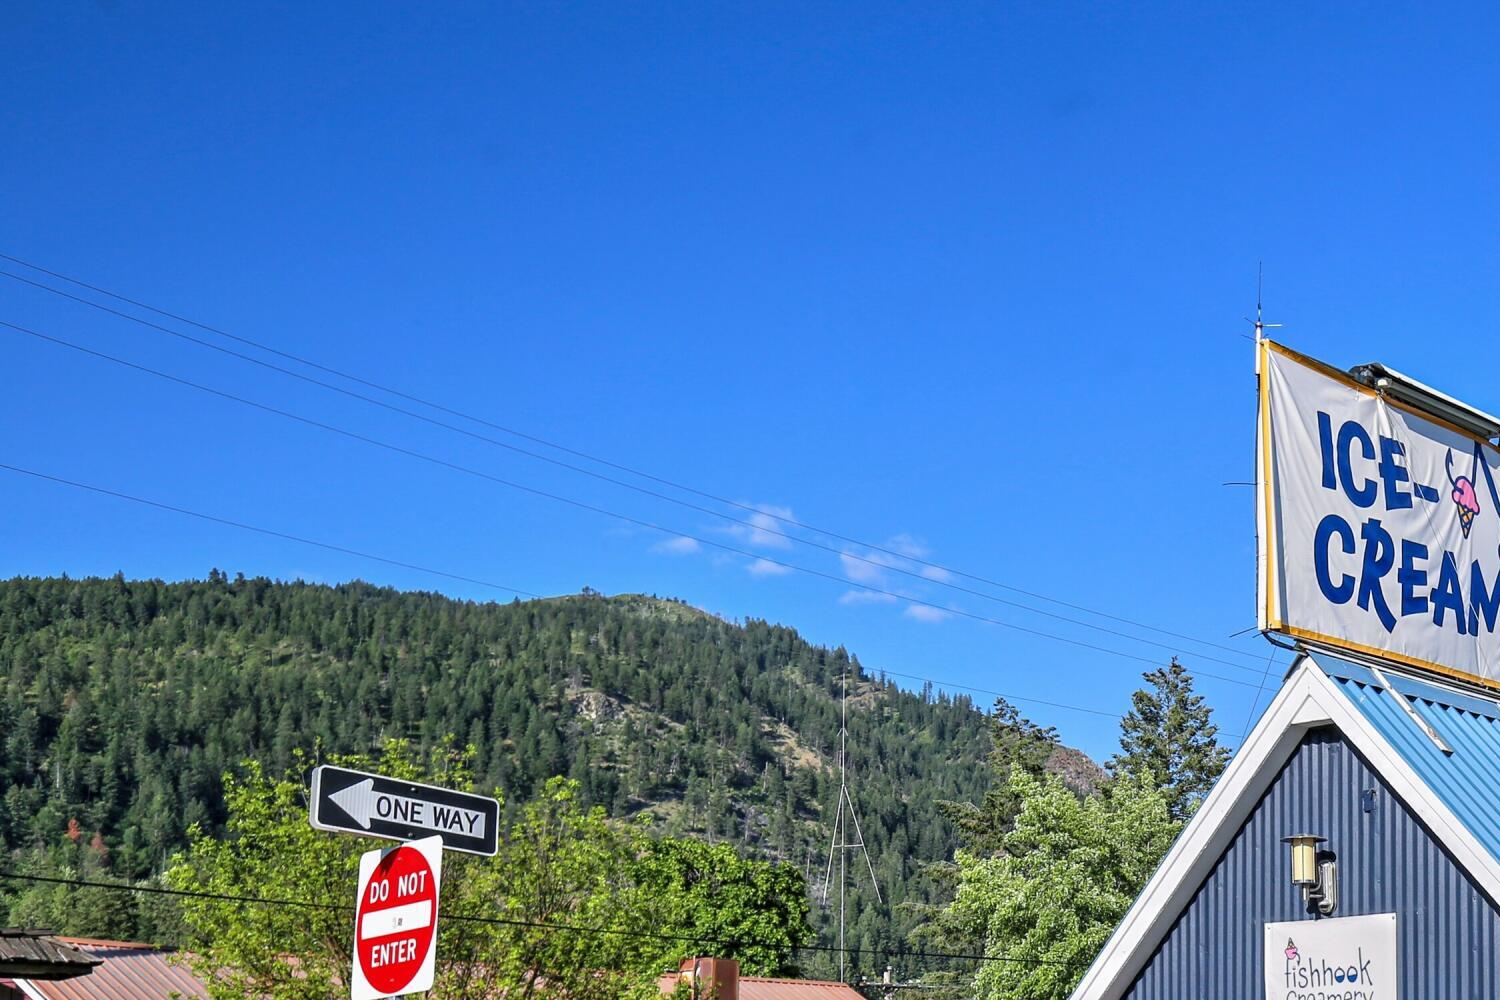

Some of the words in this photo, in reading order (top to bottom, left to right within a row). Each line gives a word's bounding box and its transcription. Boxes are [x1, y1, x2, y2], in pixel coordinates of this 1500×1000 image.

[1317, 410, 1439, 511] ICE-
[376, 796, 424, 824] ONE
[433, 806, 480, 834] WAY
[370, 880, 389, 904] DO
[397, 870, 428, 898] NOT
[371, 938, 417, 968] ENTER
